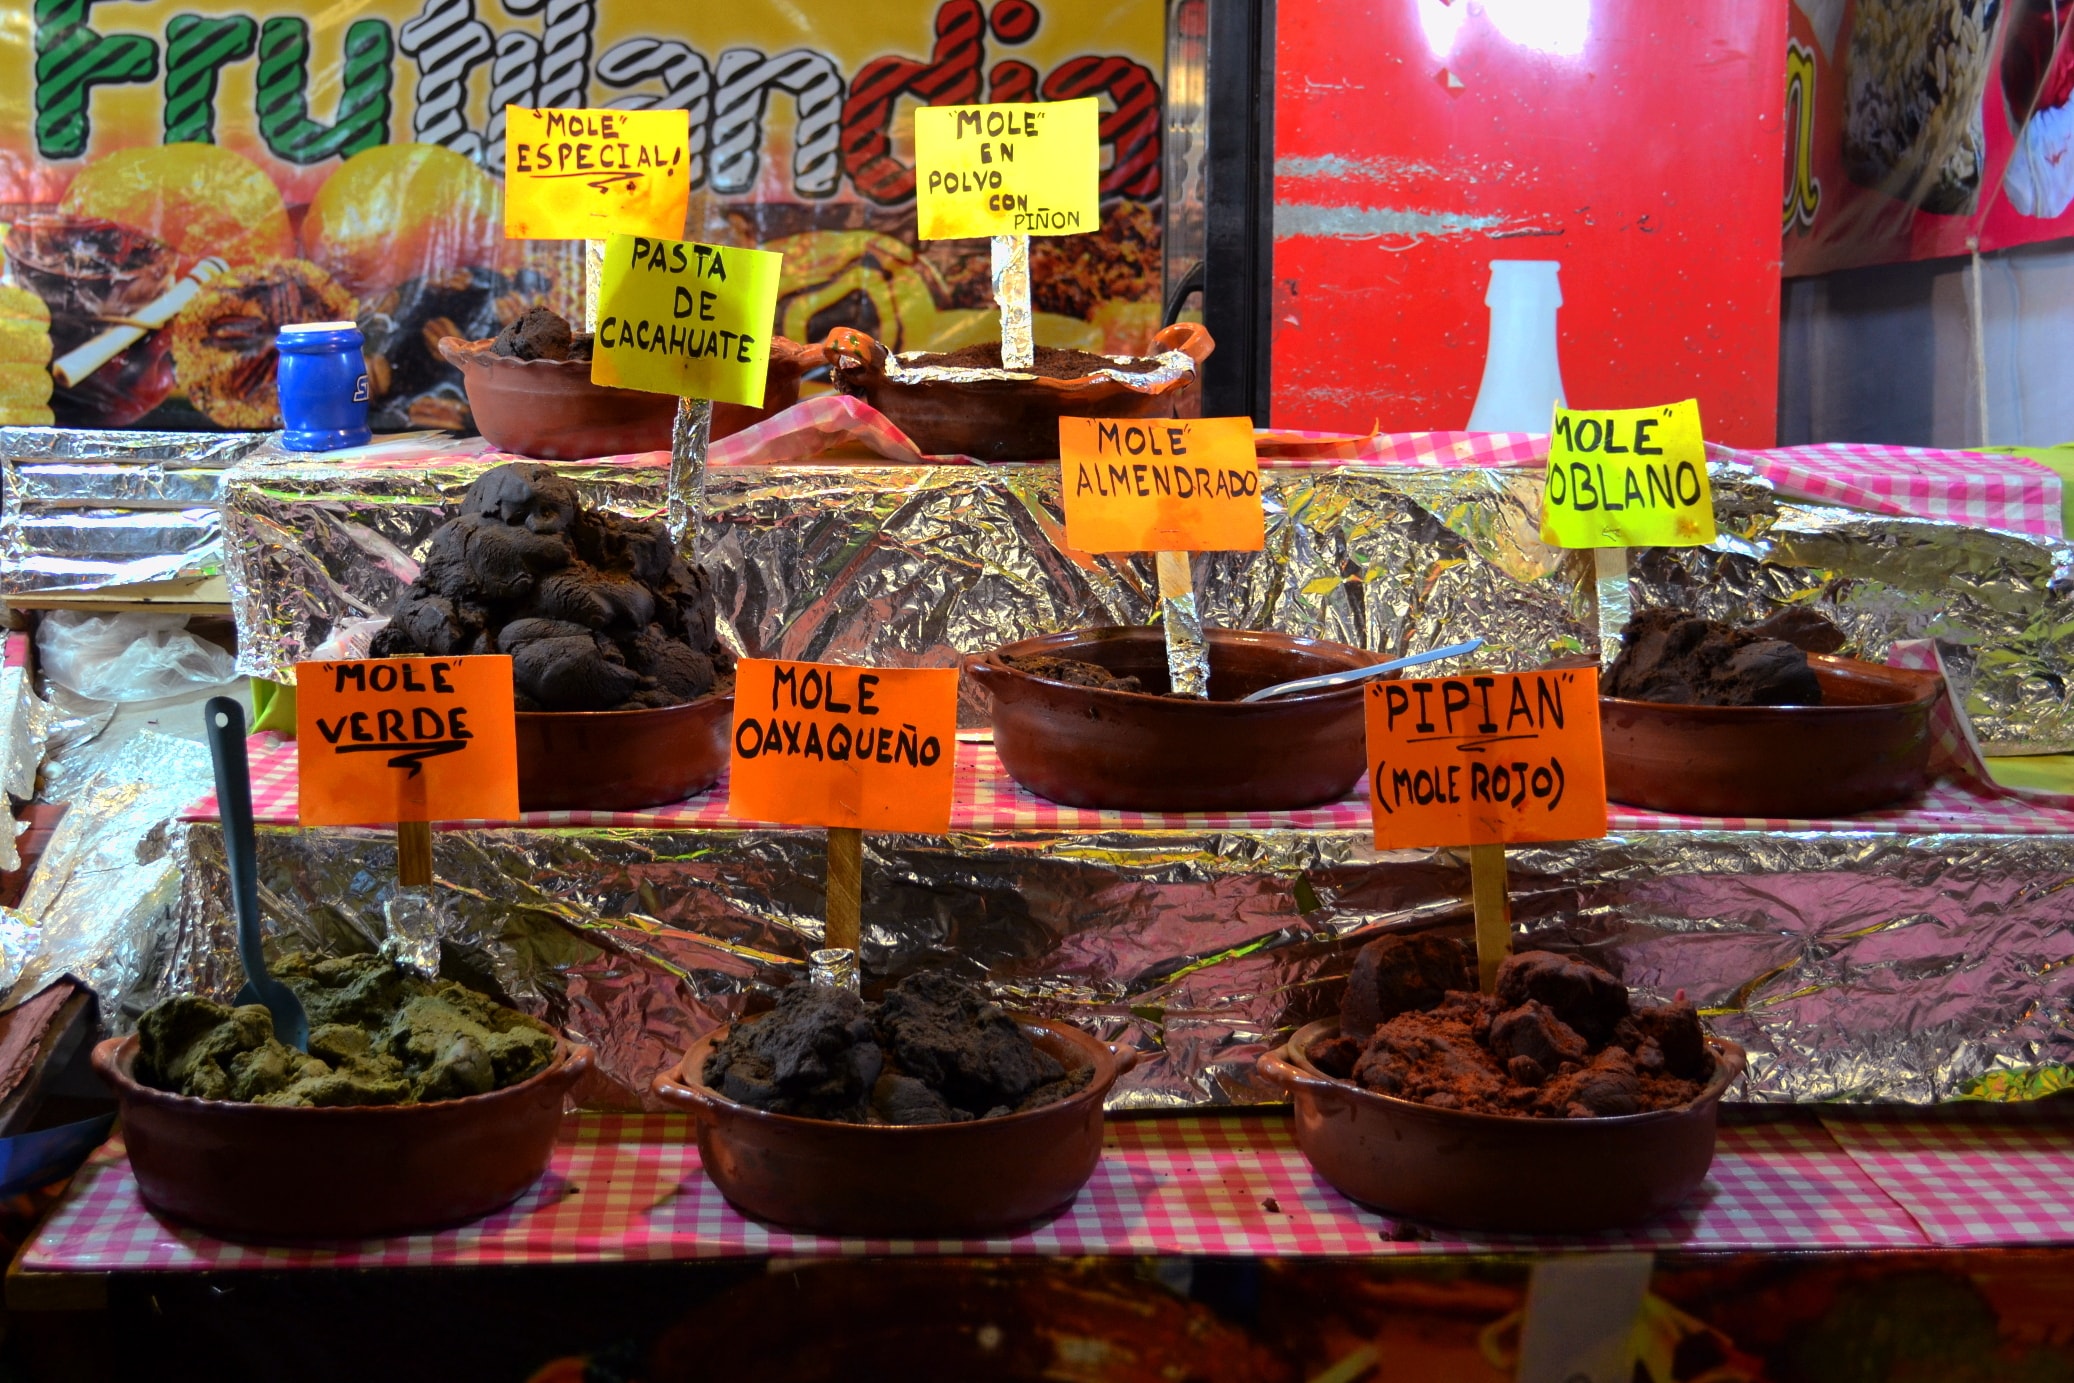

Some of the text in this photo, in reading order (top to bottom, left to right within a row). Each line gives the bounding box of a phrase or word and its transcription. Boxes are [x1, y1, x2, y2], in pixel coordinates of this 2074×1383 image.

[533, 109, 628, 139] "MOLE"
[949, 110, 1045, 140] "MOLE"
[517, 143, 681, 177] ESPECIAL!
[981, 143, 1014, 164] EN
[929, 170, 1002, 194] POLVO
[989, 194, 1028, 212] CON
[1014, 207, 1080, 231] PIÑON
[631, 237, 727, 282] PASTA
[673, 286, 718, 321] DE
[600, 317, 756, 363] CACAHUATE
[1086, 417, 1192, 456] "MOLE"
[1077, 462, 1258, 500] ALMENDRADO
[1546, 461, 1701, 511] OBLANO
[323, 659, 463, 694] "MOLE"
[772, 664, 880, 716] MOLE
[1372, 672, 1574, 733] "PIPIAN"
[316, 707, 474, 744] VERDE
[735, 718, 941, 768] OAXAQUEÑO
[1375, 757, 1565, 814] (MOLE ROJO)
